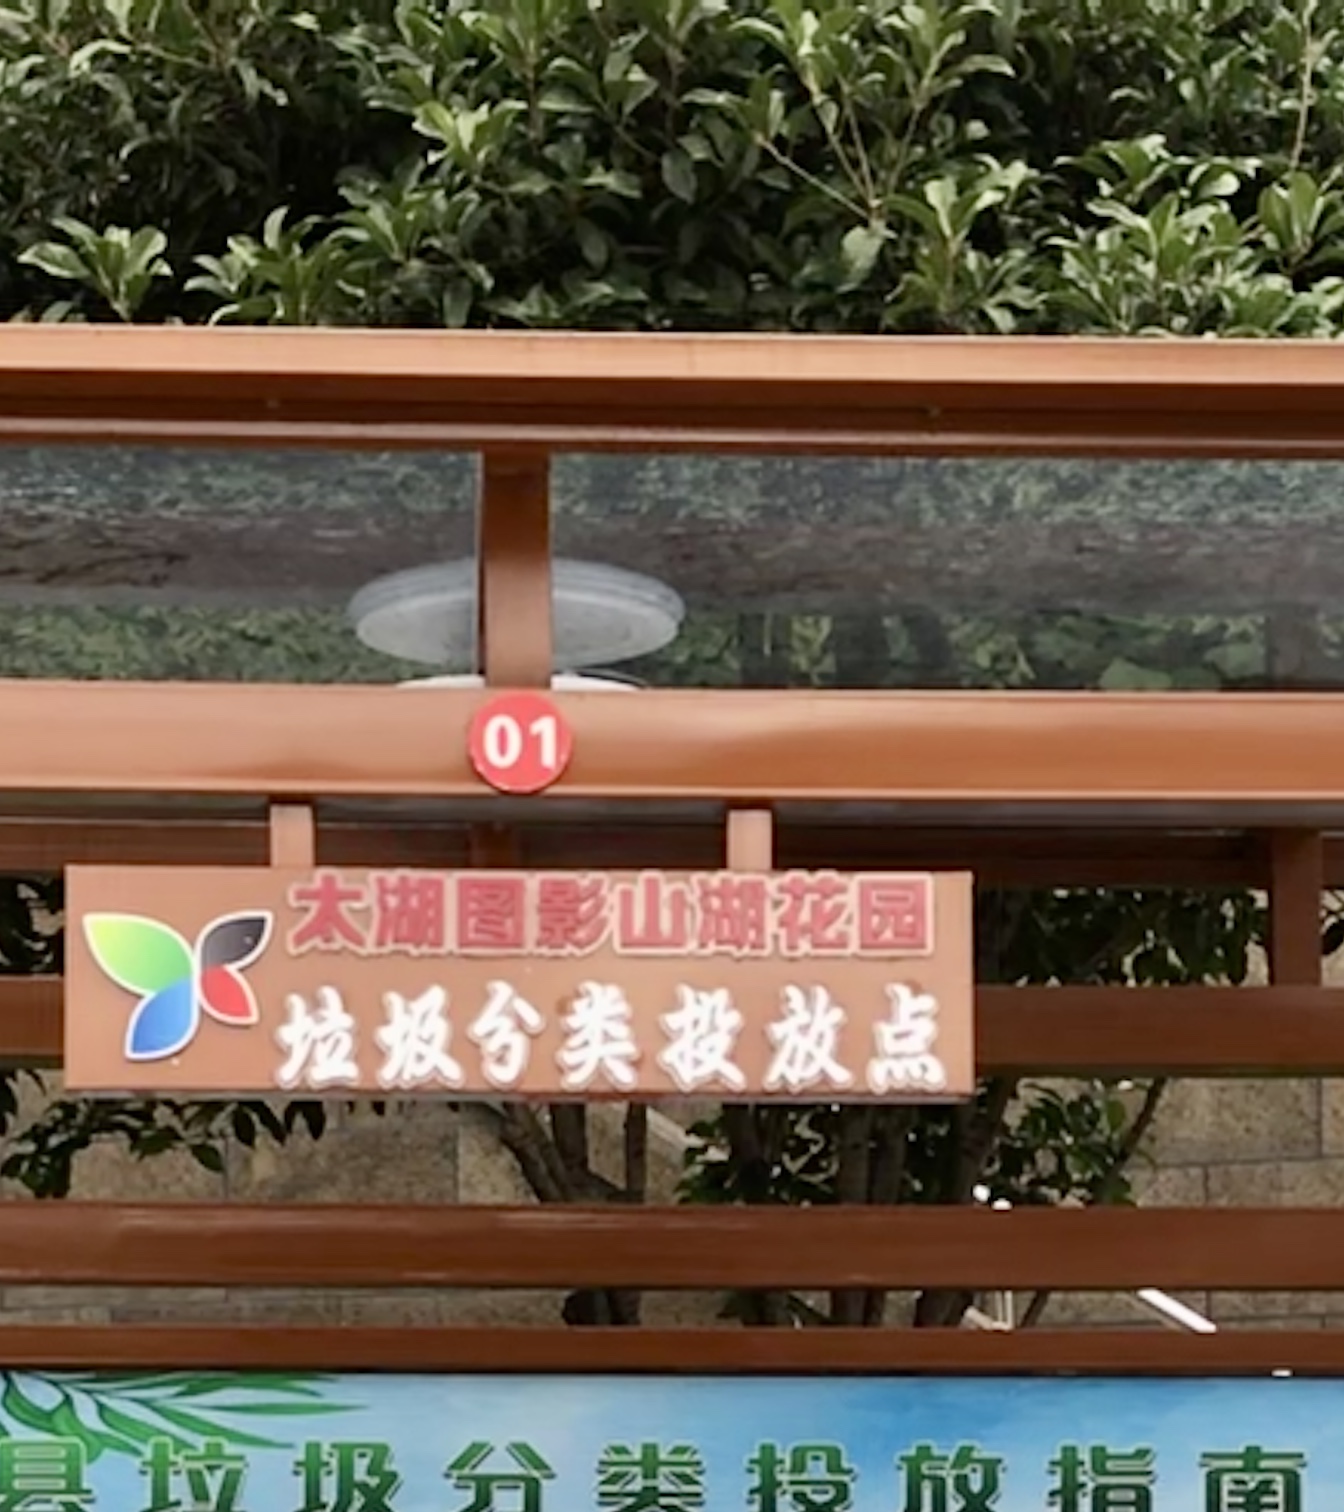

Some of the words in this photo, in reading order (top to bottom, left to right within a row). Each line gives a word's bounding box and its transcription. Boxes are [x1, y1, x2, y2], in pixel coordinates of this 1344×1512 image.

[482, 715, 560, 770] 01
[288, 872, 934, 954] 太湖图影山湖花园
[274, 982, 946, 1092] 垃圾分类投放点
